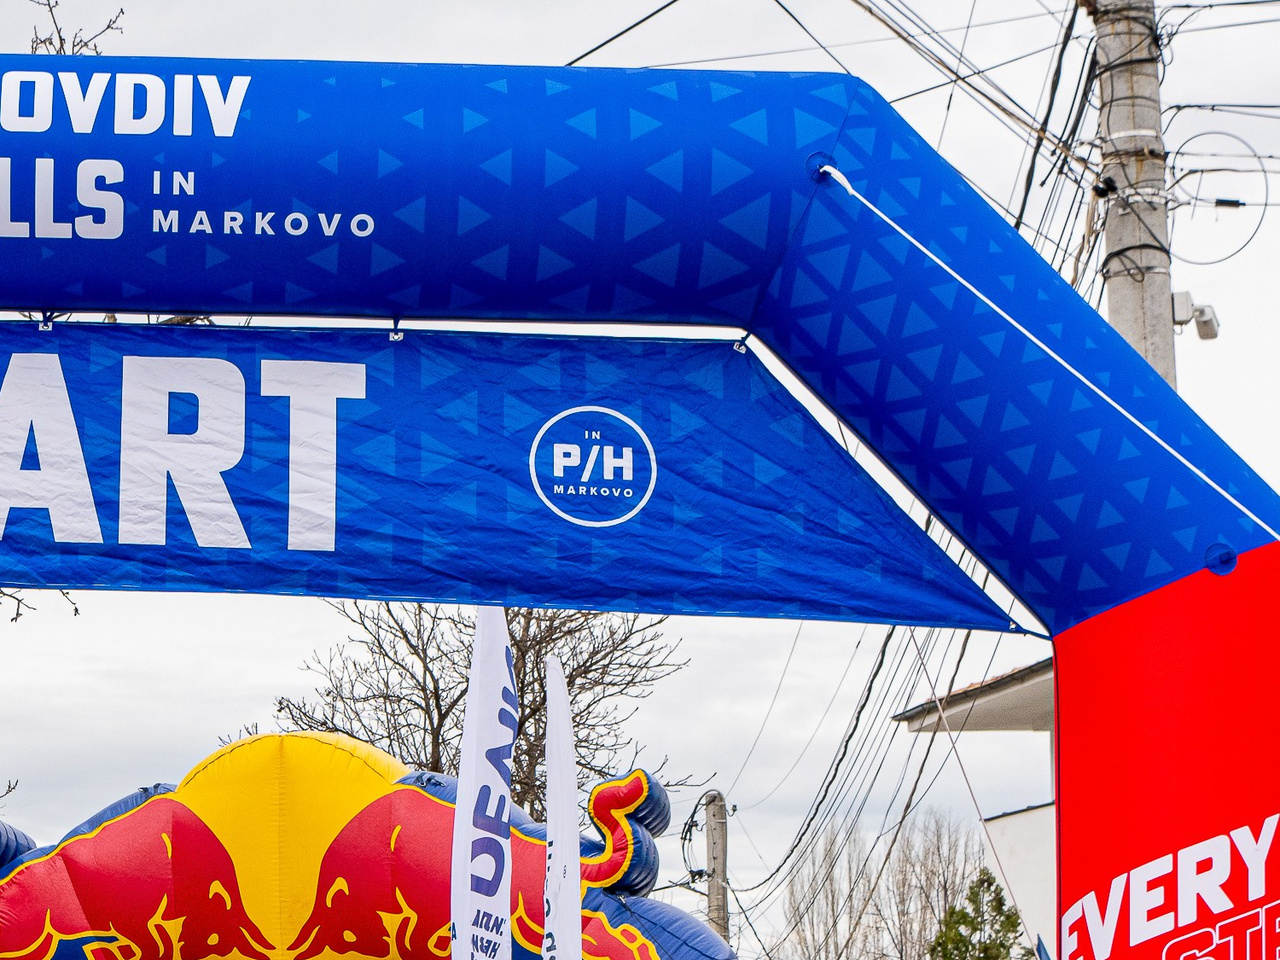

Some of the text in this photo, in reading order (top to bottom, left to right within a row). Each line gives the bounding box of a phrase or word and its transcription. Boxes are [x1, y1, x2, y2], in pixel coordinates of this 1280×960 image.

[153, 171, 195, 197] IN
[153, 210, 376, 237] MARKOVO
[584, 430, 601, 440] IN
[553, 443, 633, 483] P/H
[553, 485, 634, 498] MARKOVO
